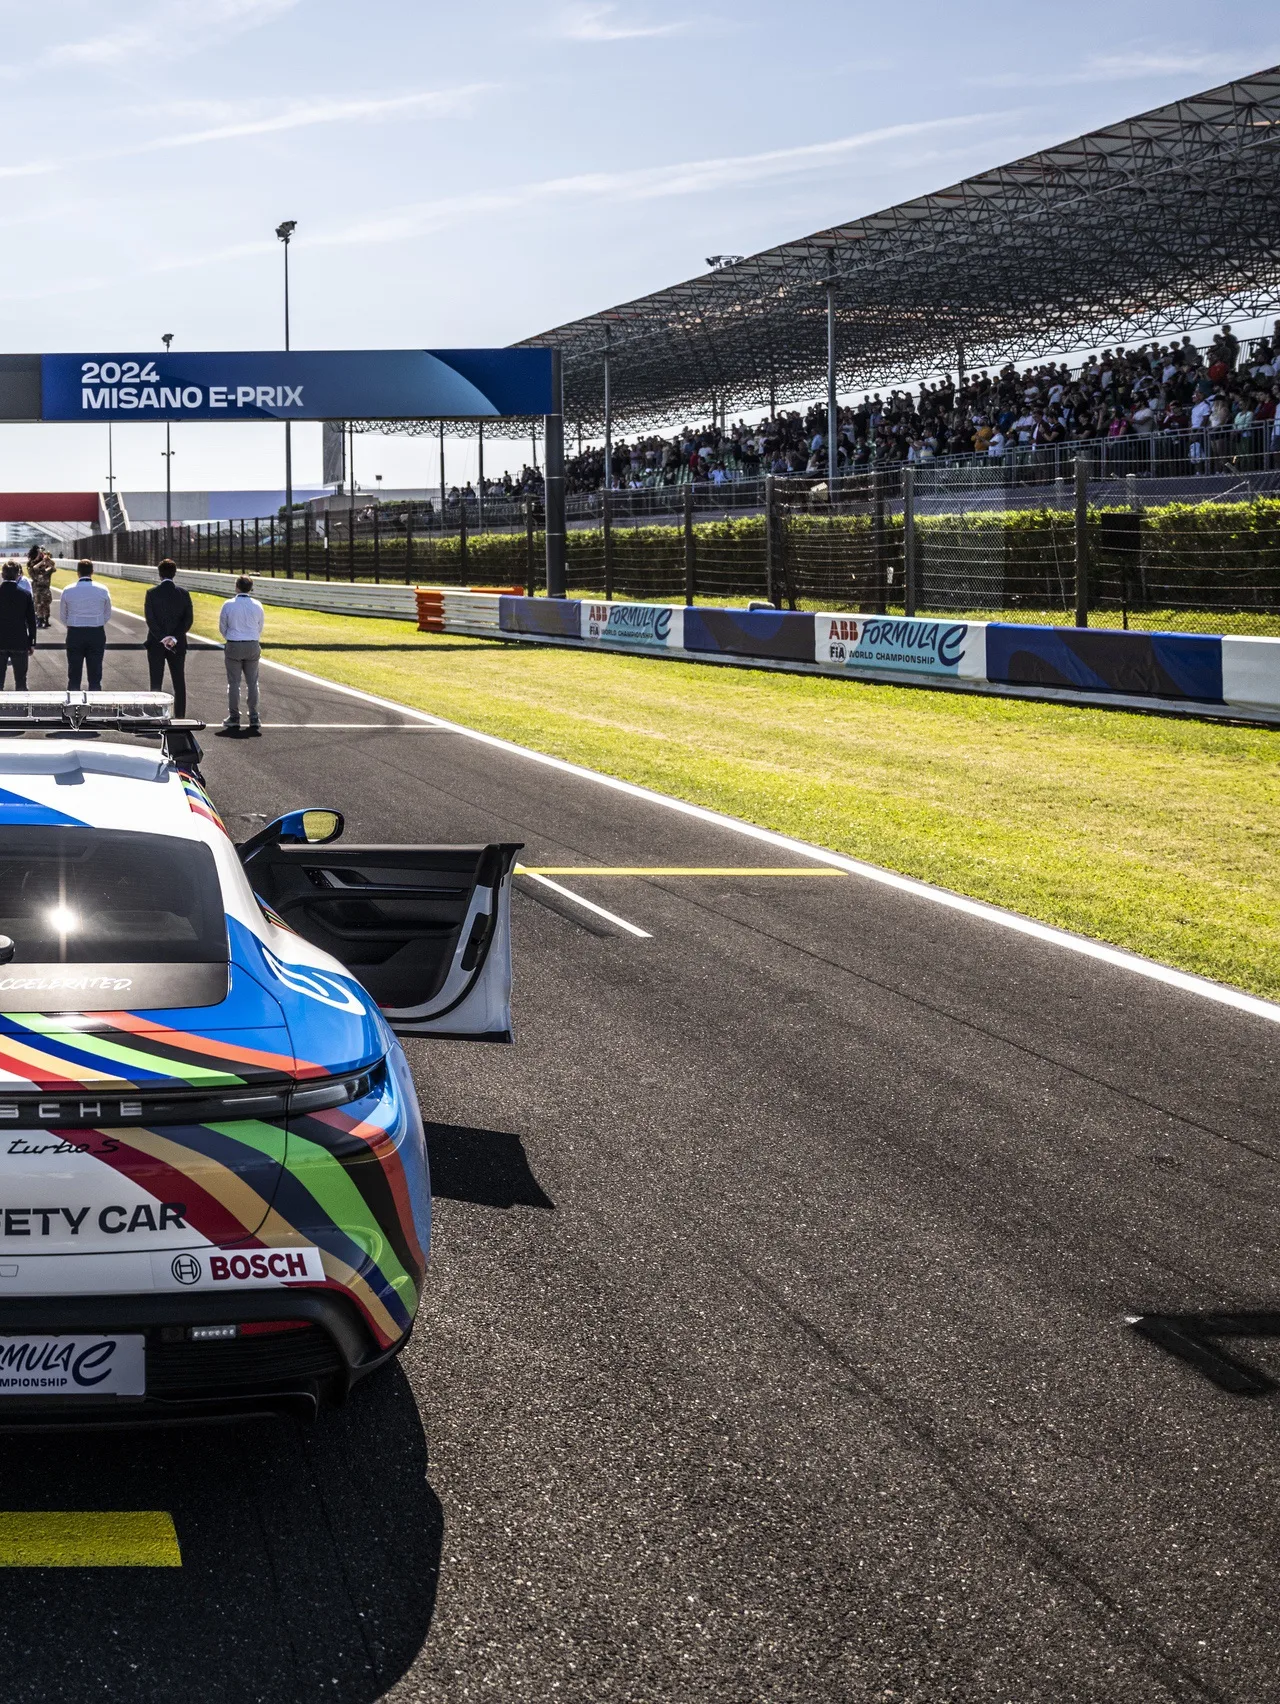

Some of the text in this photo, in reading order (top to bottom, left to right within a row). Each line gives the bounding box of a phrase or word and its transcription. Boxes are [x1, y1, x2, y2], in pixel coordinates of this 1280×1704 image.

[81, 361, 160, 384] 2024
[82, 385, 304, 409] MISANO E-PRIX
[588, 605, 608, 622] ABB
[608, 605, 656, 629] FORMULA
[828, 620, 859, 642] ABB
[859, 619, 940, 651] FORMULA
[848, 650, 873, 660] WORLD
[875, 652, 936, 665] CHAMPIONSHIP
[7, 1138, 91, 1155] turbo
[94, 1138, 121, 1154] S
[98, 1202, 187, 1234] CAR
[209, 1253, 308, 1281] BOSCH
